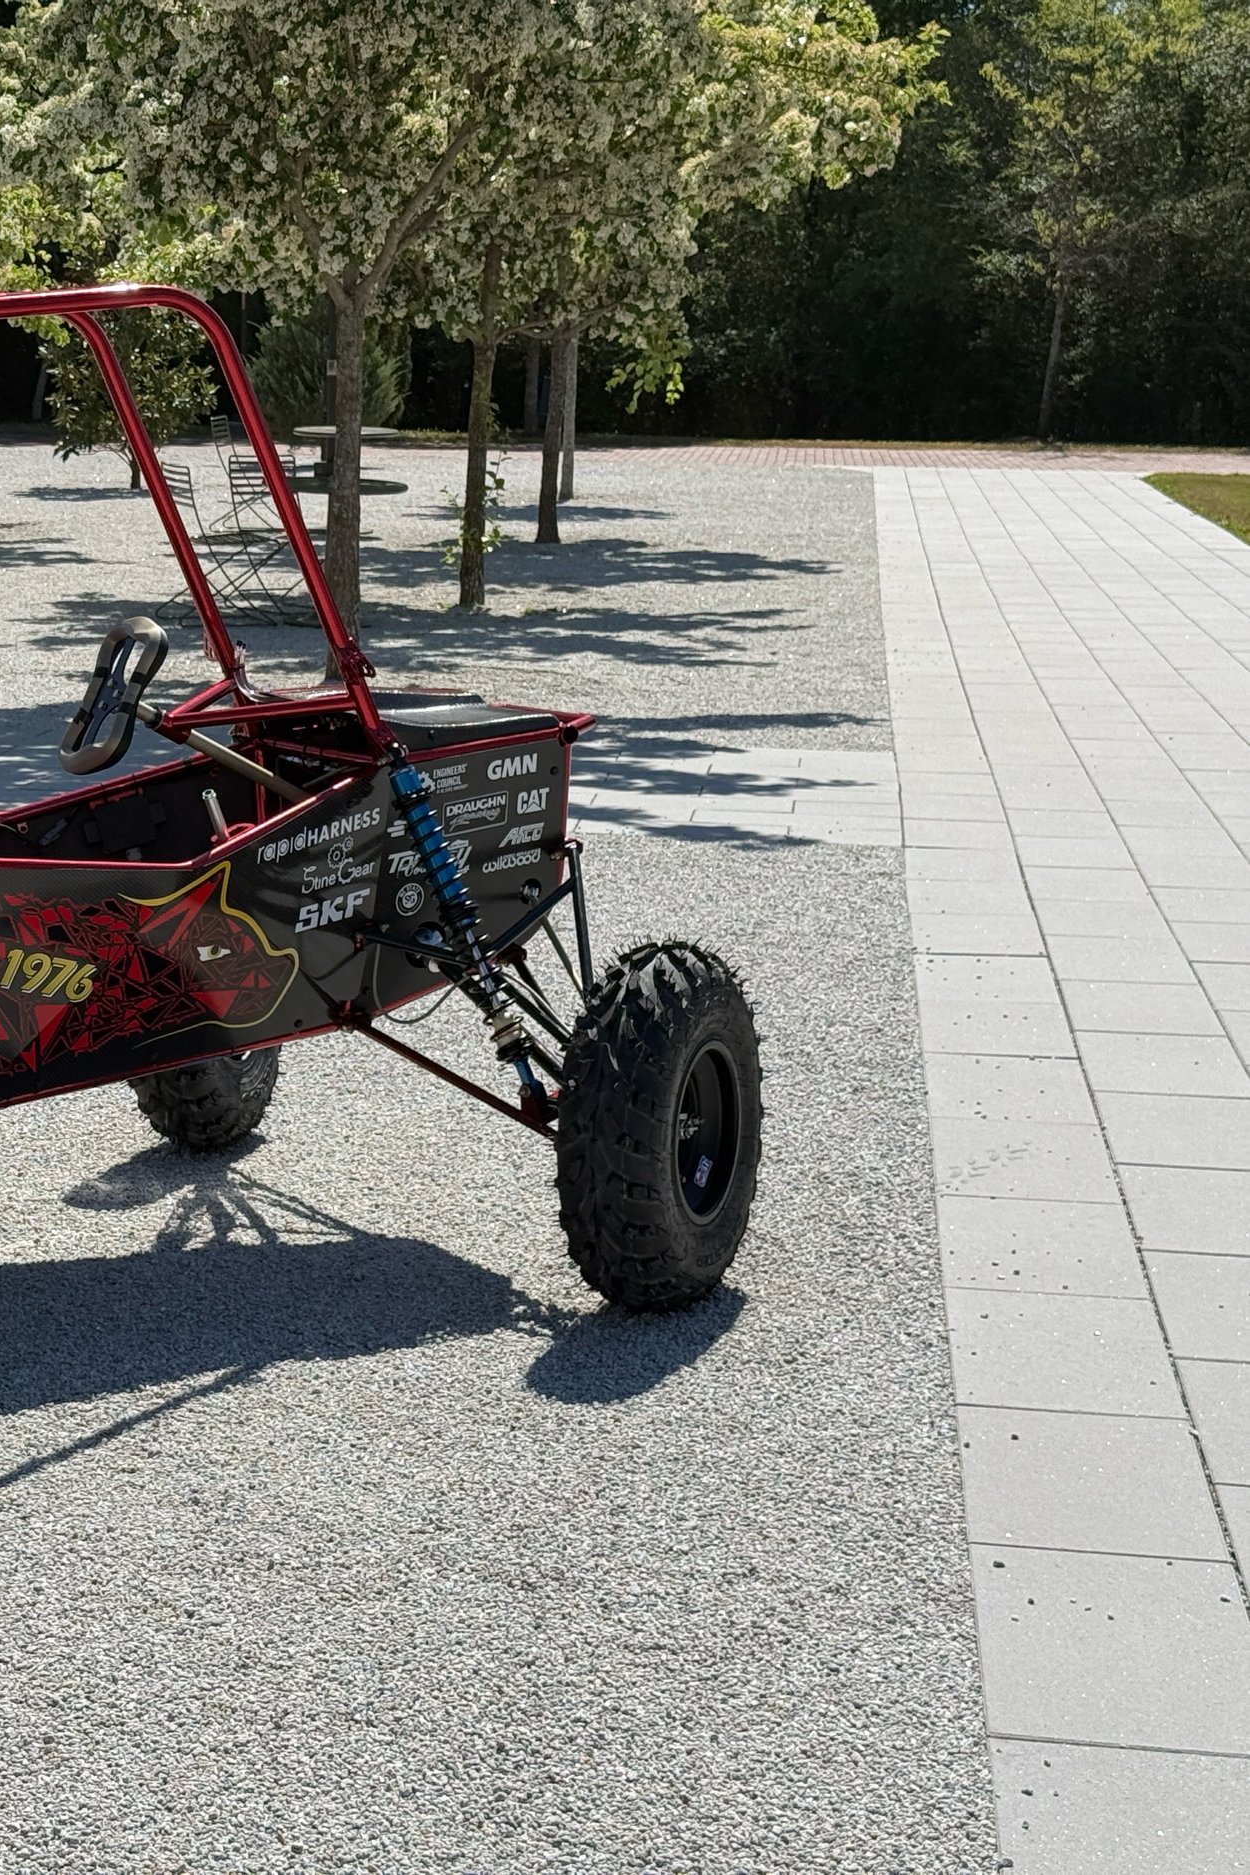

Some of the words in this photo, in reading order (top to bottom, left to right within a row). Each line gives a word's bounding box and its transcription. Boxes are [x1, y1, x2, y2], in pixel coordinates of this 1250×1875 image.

[487, 753, 538, 780] GMN
[437, 776, 461, 789] COUNCIL
[446, 795, 506, 817] DRAUGHN
[517, 787, 550, 814] CAT
[295, 888, 370, 933] SKF
[0, 948, 98, 1003] 1976
